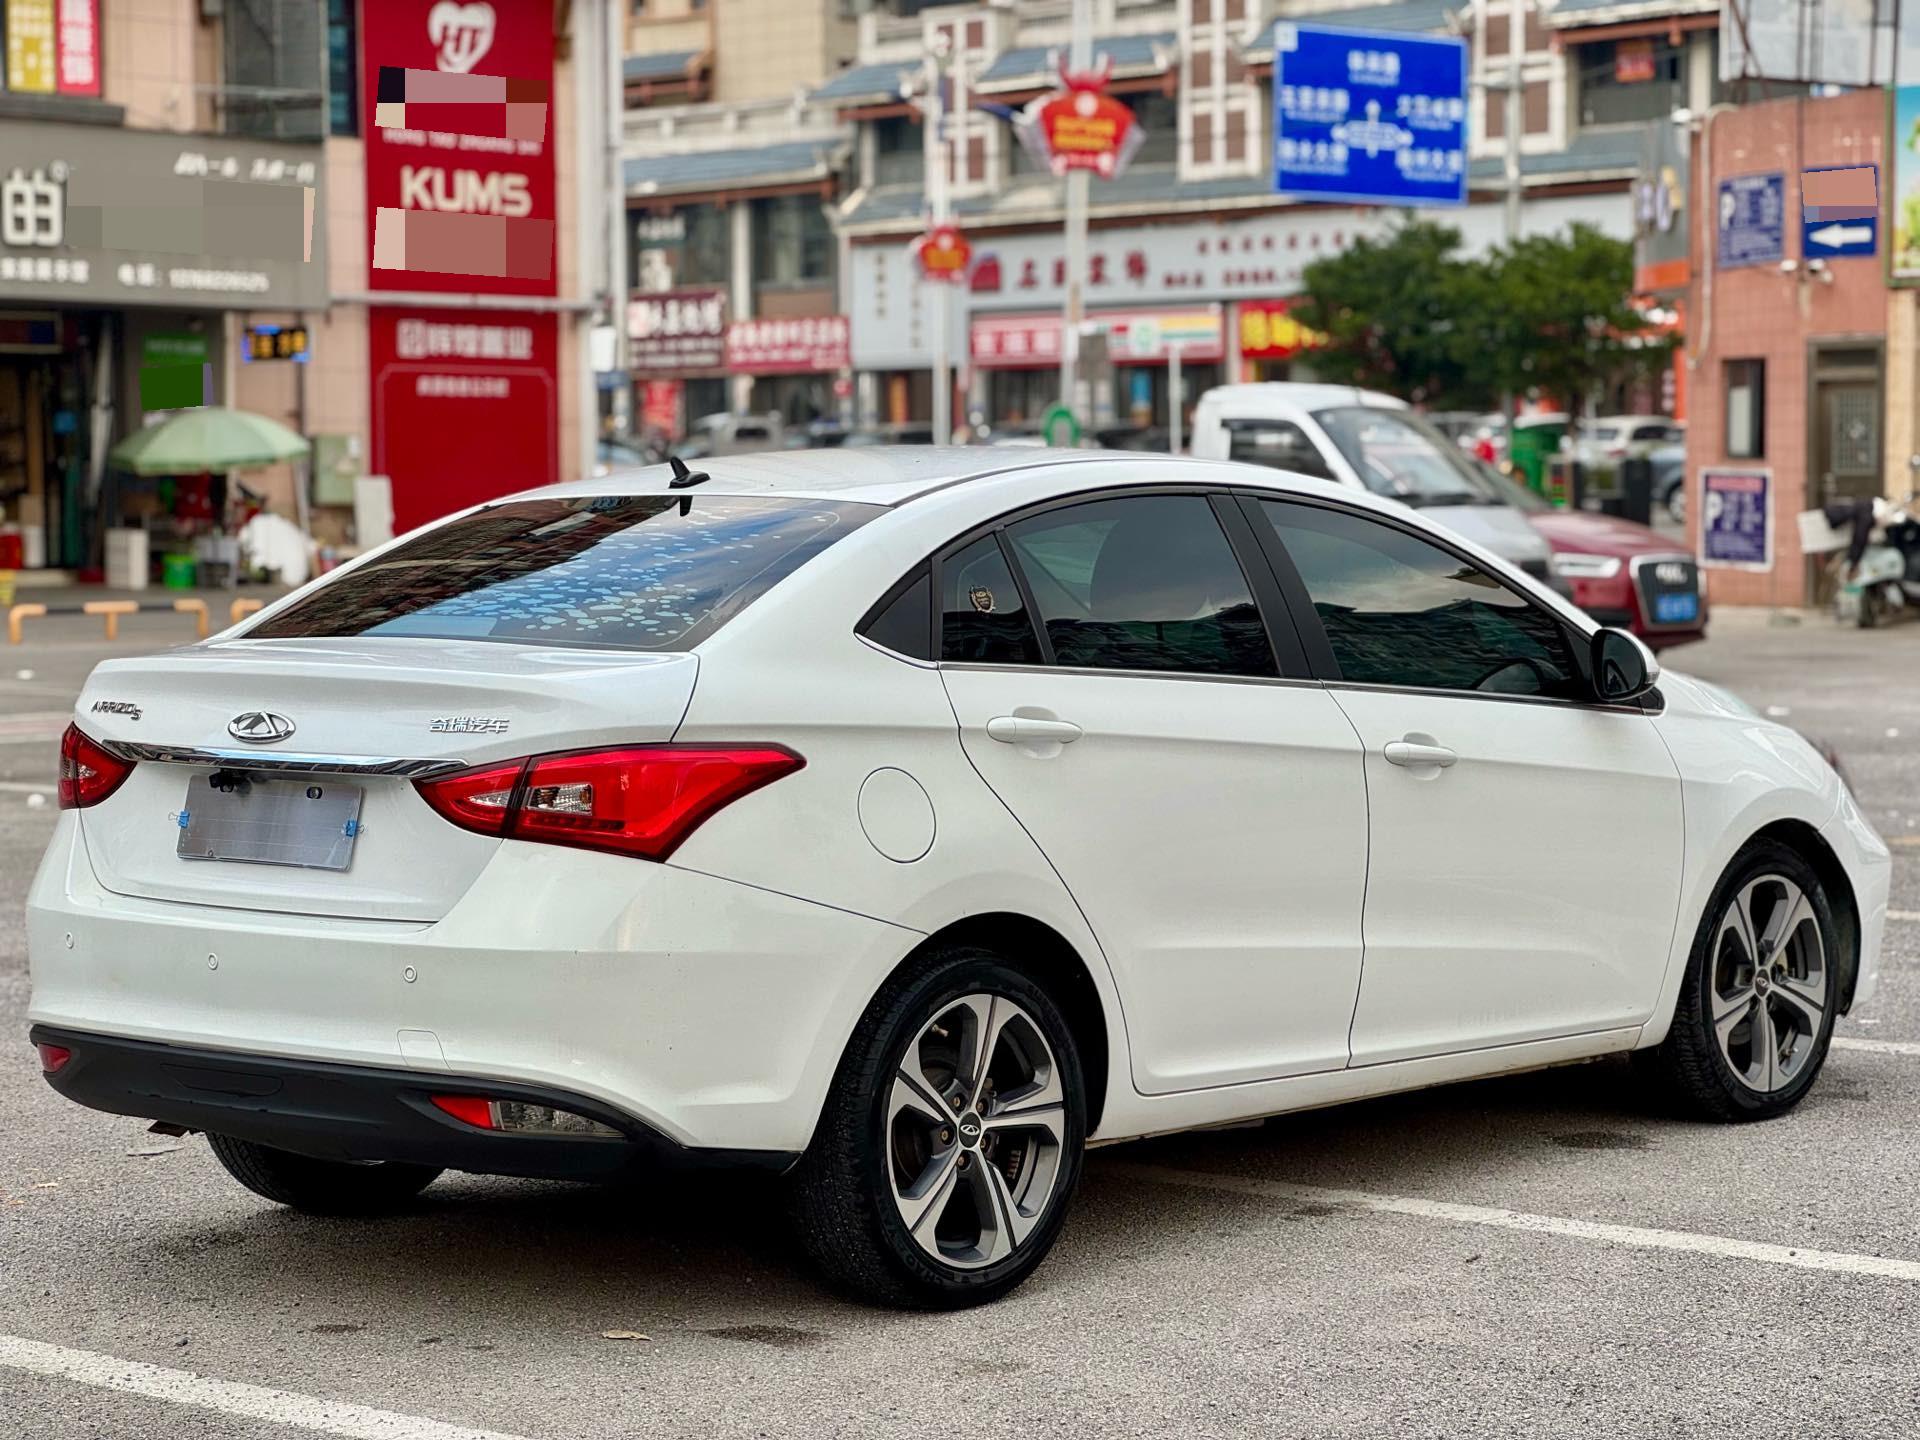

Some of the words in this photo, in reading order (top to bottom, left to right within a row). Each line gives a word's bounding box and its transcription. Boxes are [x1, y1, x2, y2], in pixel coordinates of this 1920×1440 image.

[401, 165, 532, 217] KUMS
[429, 717, 510, 734] 奇瑞汽车
